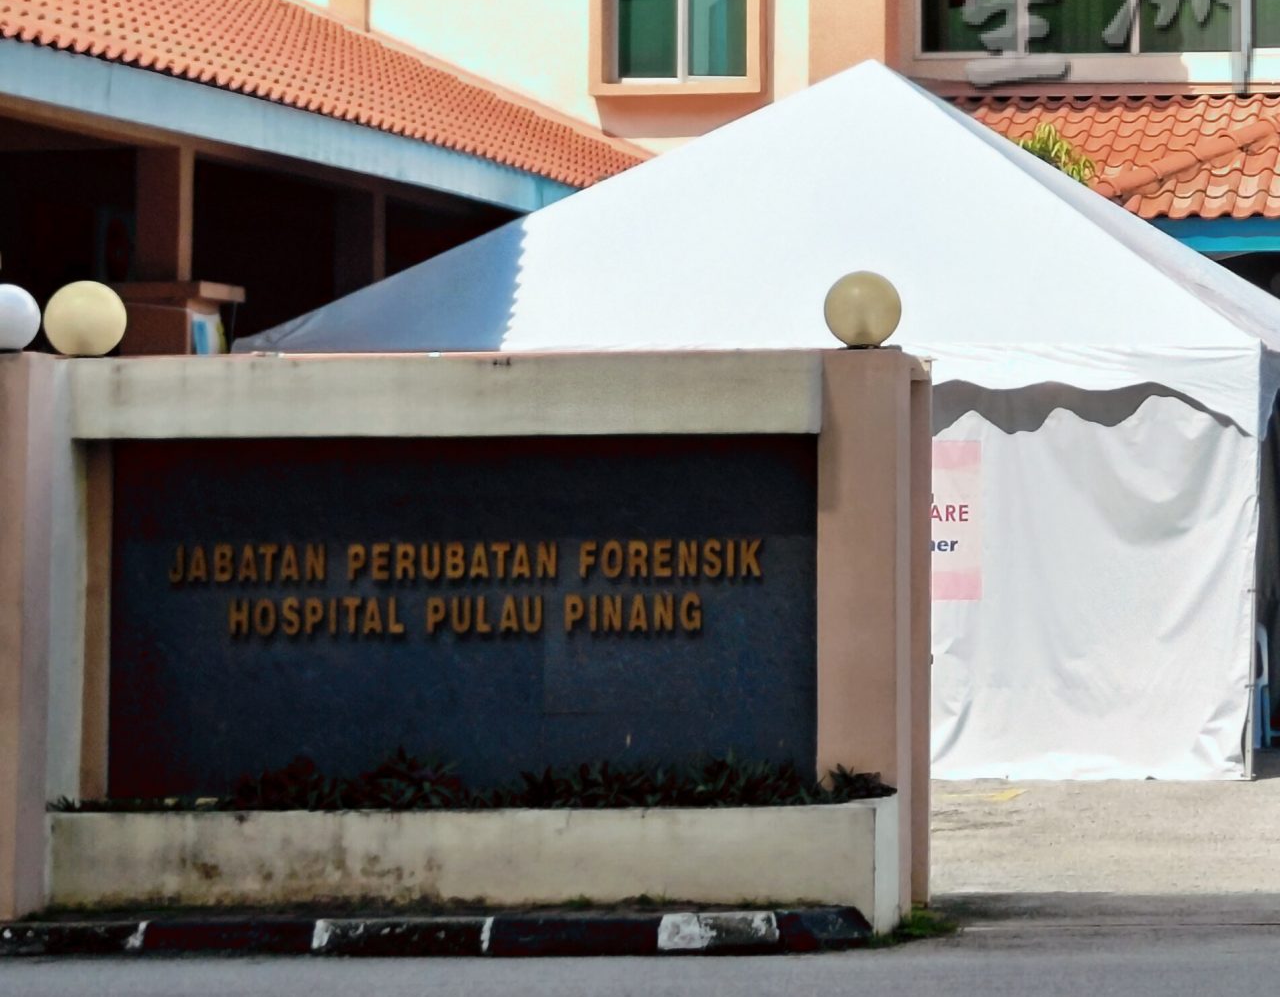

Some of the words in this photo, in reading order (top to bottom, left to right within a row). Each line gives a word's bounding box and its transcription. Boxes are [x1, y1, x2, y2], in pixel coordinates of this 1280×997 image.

[169, 543, 326, 583] JABATAN
[347, 541, 557, 581] PERUBATAN
[578, 538, 763, 578] FORENSIK
[228, 596, 405, 635] HOSPITAL
[426, 595, 543, 634] PULAU
[563, 591, 702, 632] PINANG
